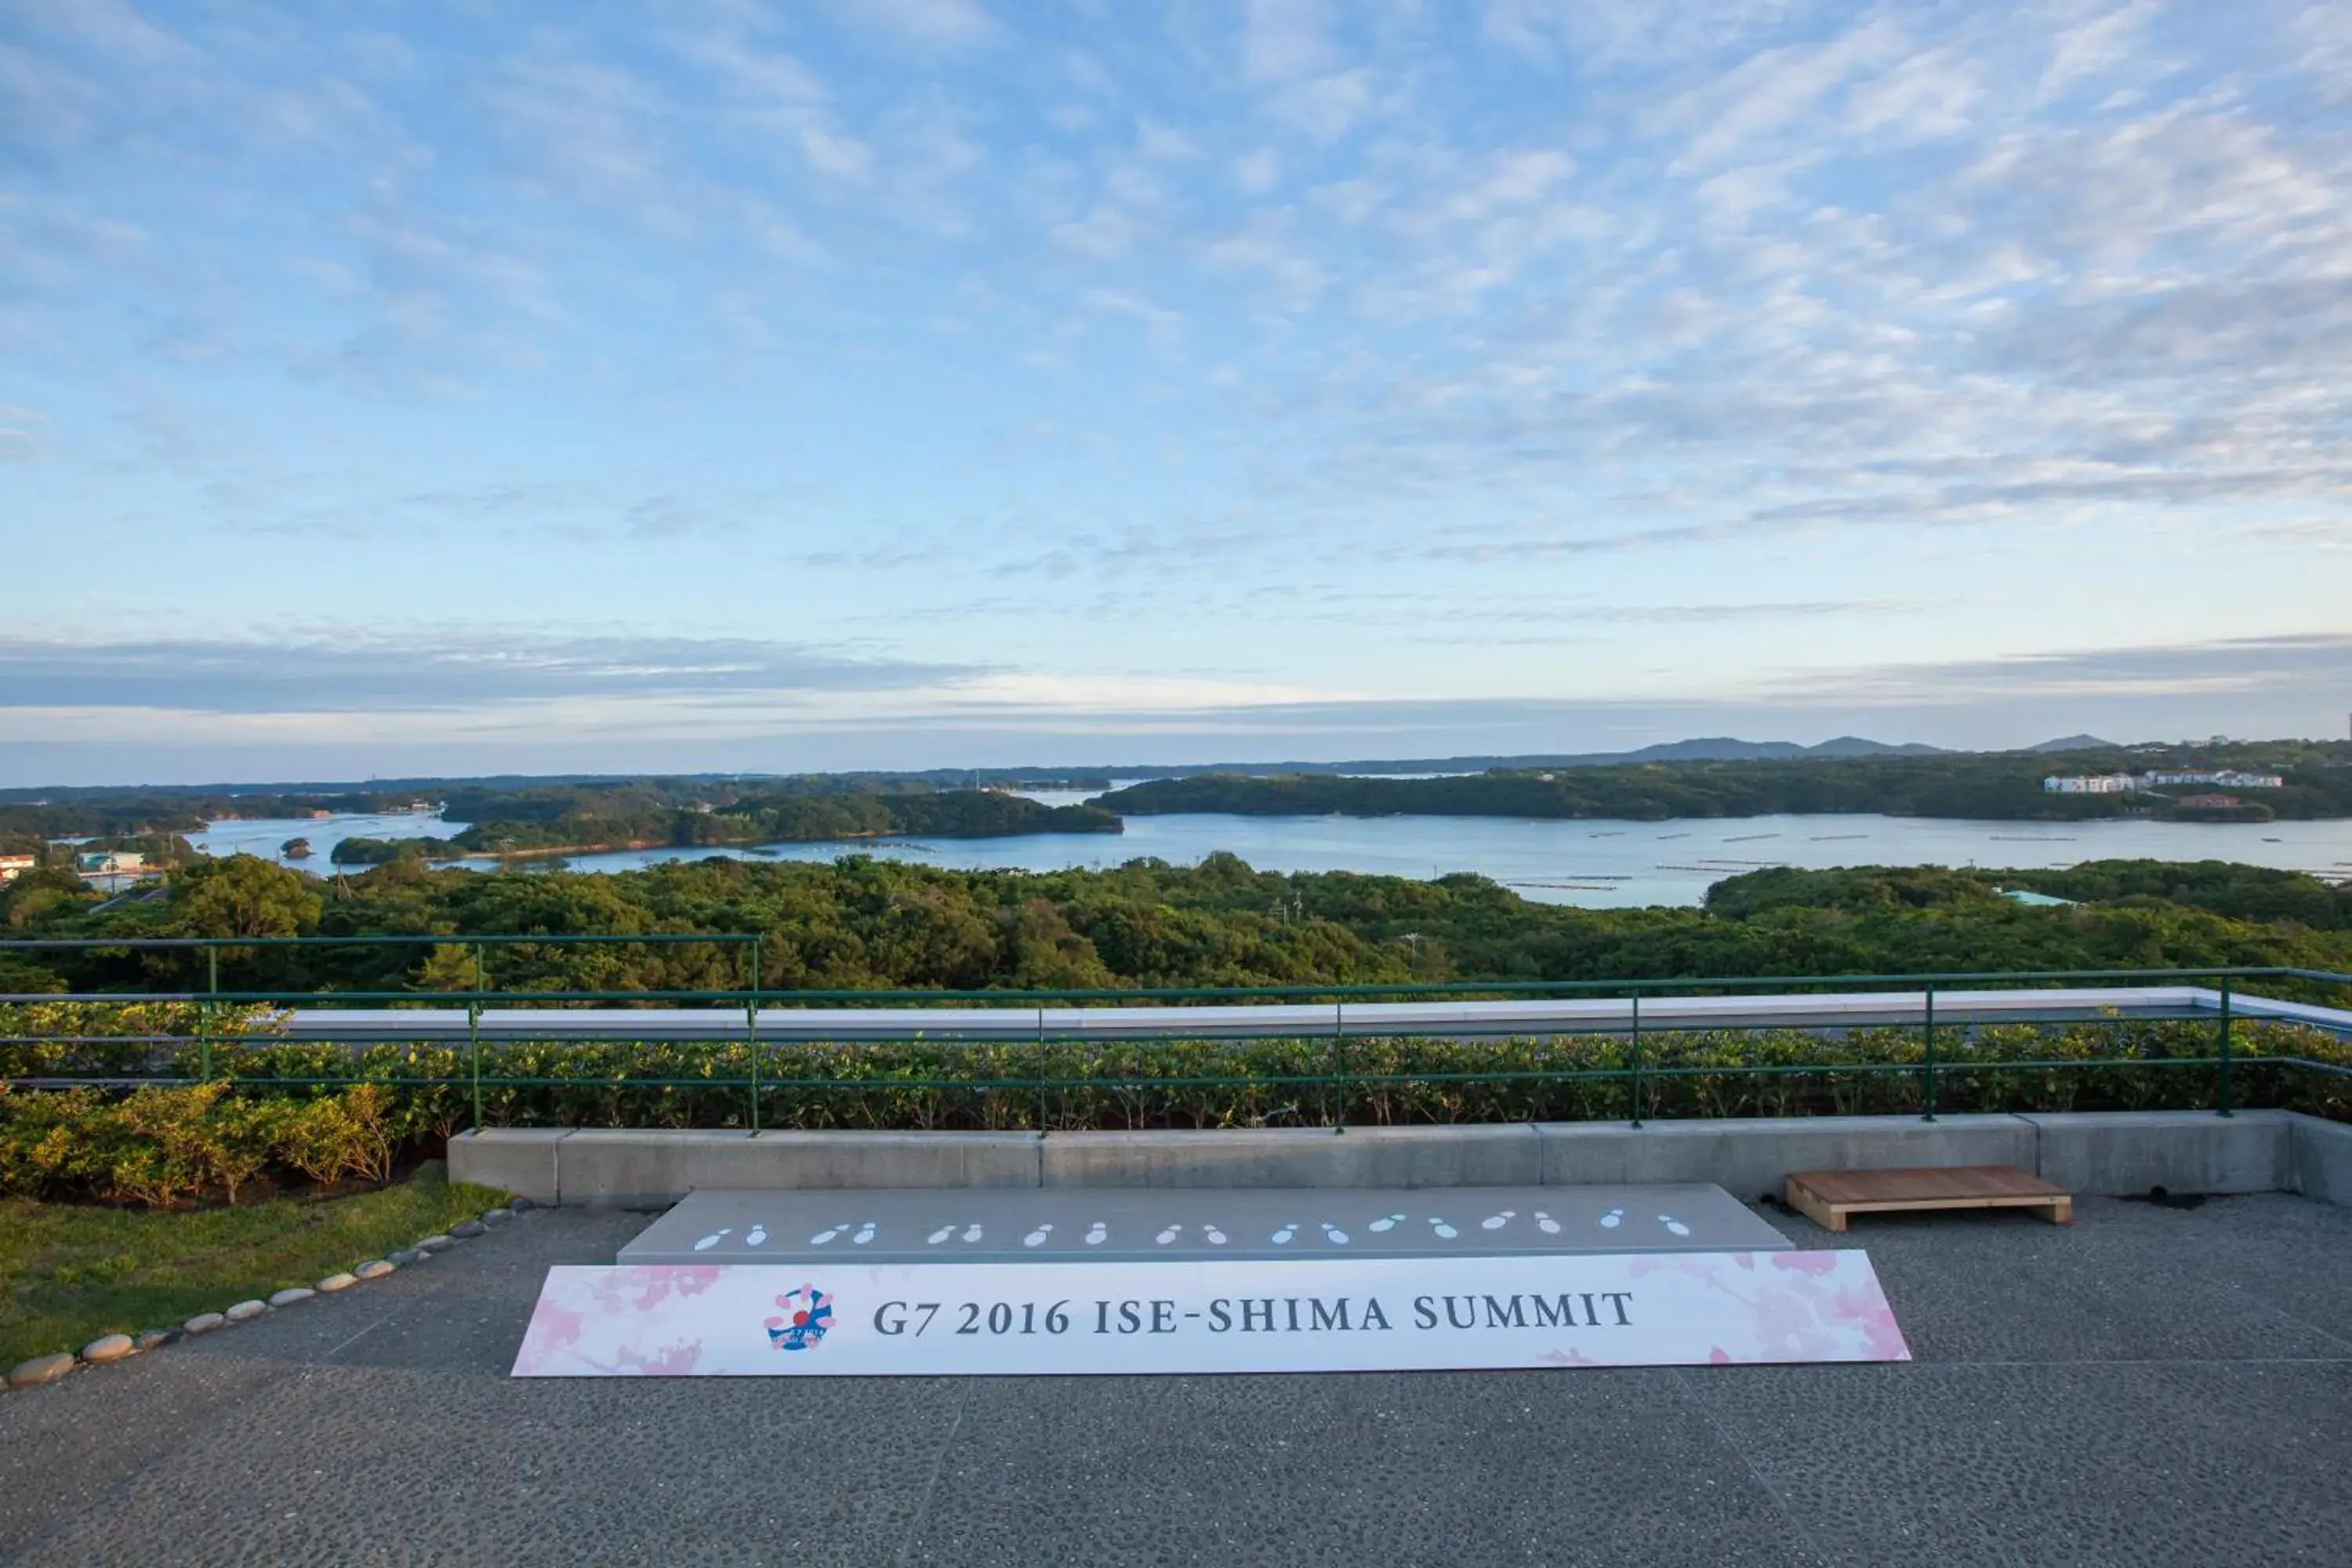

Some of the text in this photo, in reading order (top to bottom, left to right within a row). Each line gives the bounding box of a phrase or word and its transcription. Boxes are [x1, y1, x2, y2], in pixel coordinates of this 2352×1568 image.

[873, 1291, 1634, 1338] G7 2016 ISE-SHIMA SUMMIT
